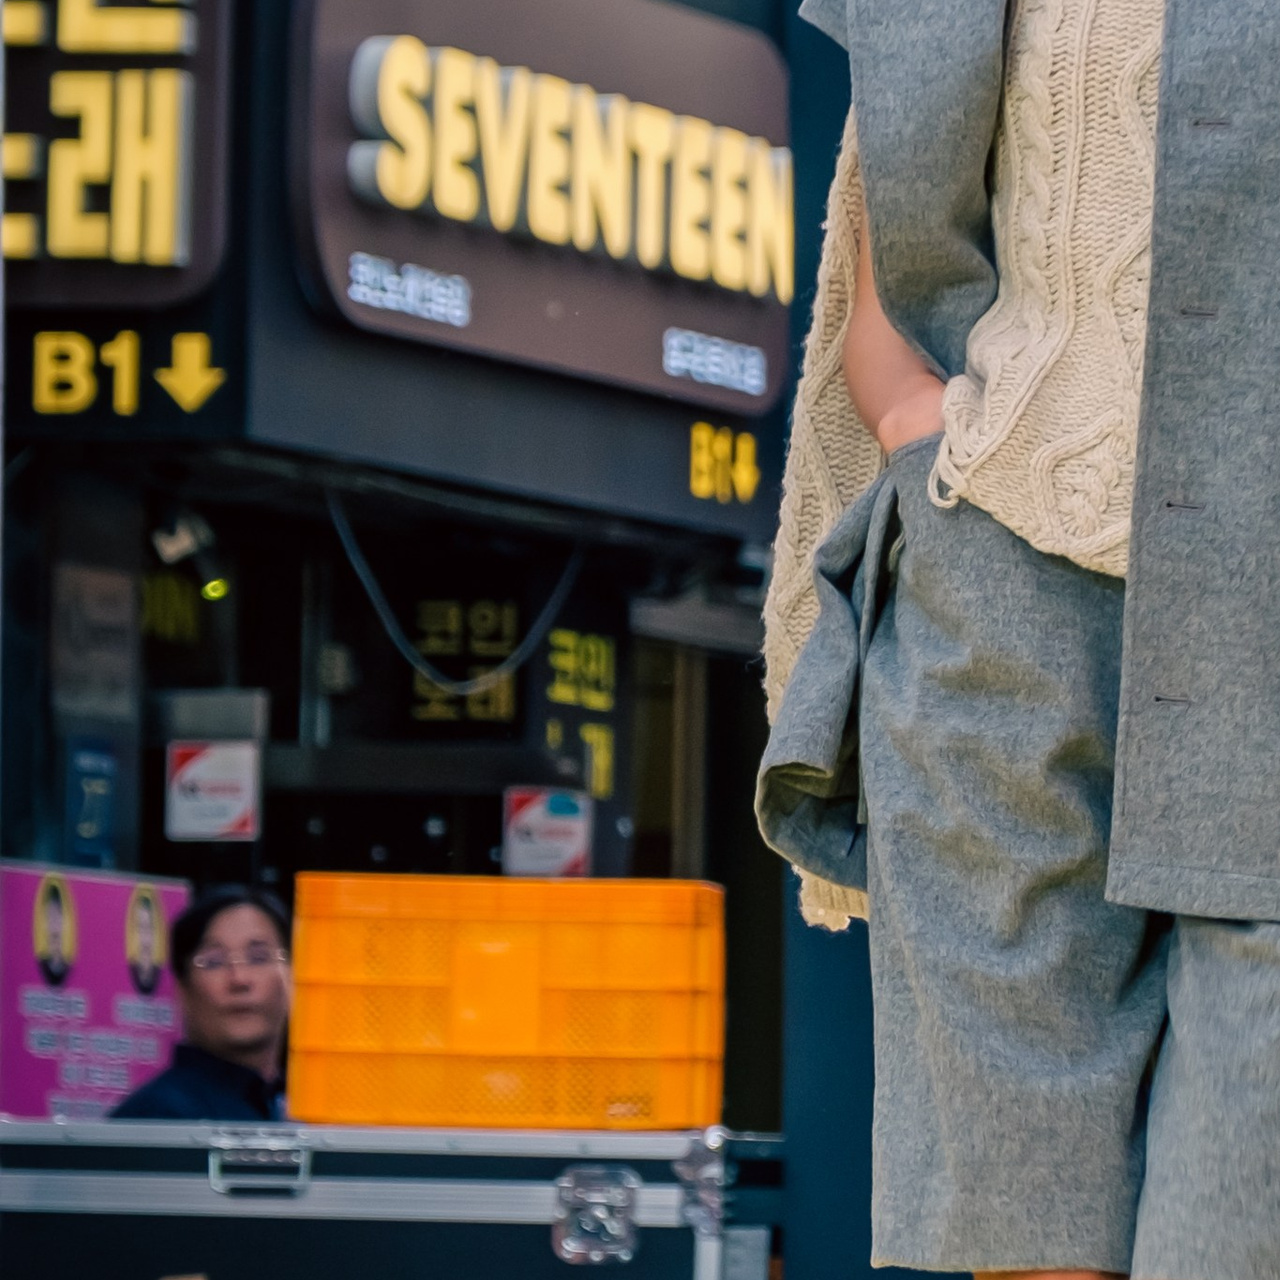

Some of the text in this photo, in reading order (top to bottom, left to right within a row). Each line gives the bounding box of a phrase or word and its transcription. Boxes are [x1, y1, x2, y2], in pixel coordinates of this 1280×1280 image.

[4, 68, 196, 267] 래
[370, 33, 795, 305] SEVENTEEN
[32, 330, 141, 416] B1
[690, 421, 733, 504] B1
